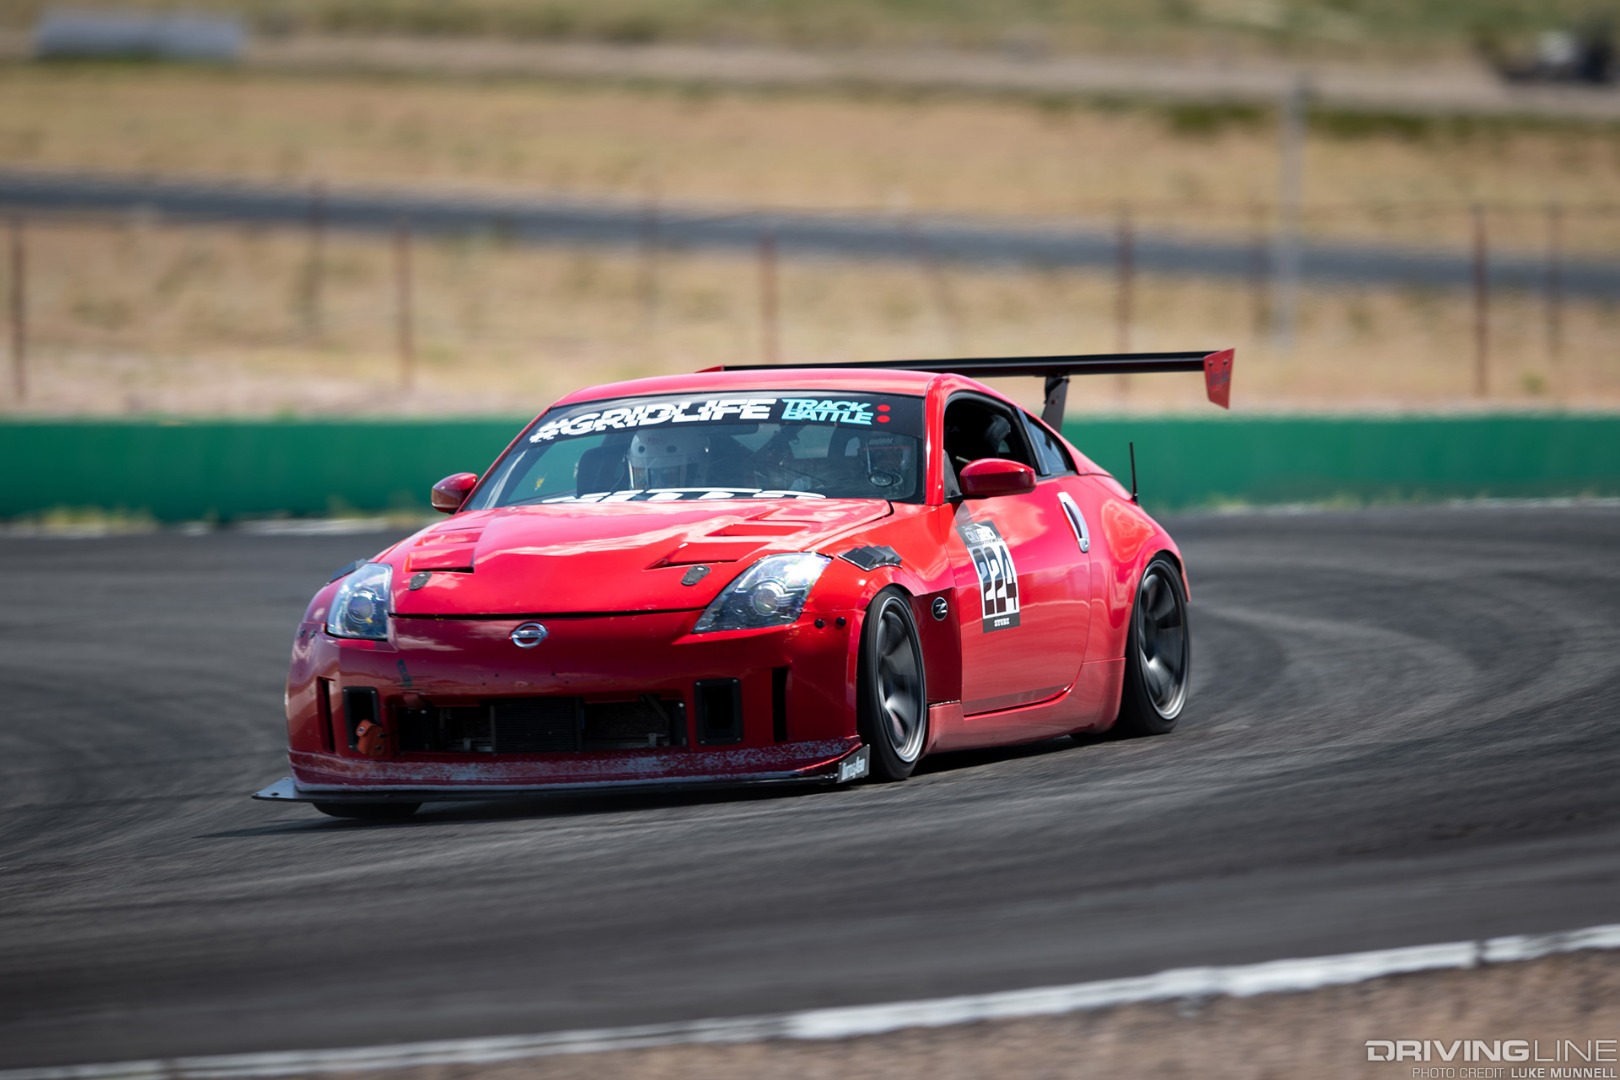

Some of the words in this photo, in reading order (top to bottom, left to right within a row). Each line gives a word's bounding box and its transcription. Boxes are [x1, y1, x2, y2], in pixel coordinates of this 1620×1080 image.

[781, 409, 874, 425] BATTLE
[782, 398, 872, 412] TRACK
[529, 399, 777, 443] #GRIDLIFE
[972, 545, 1017, 616] 224
